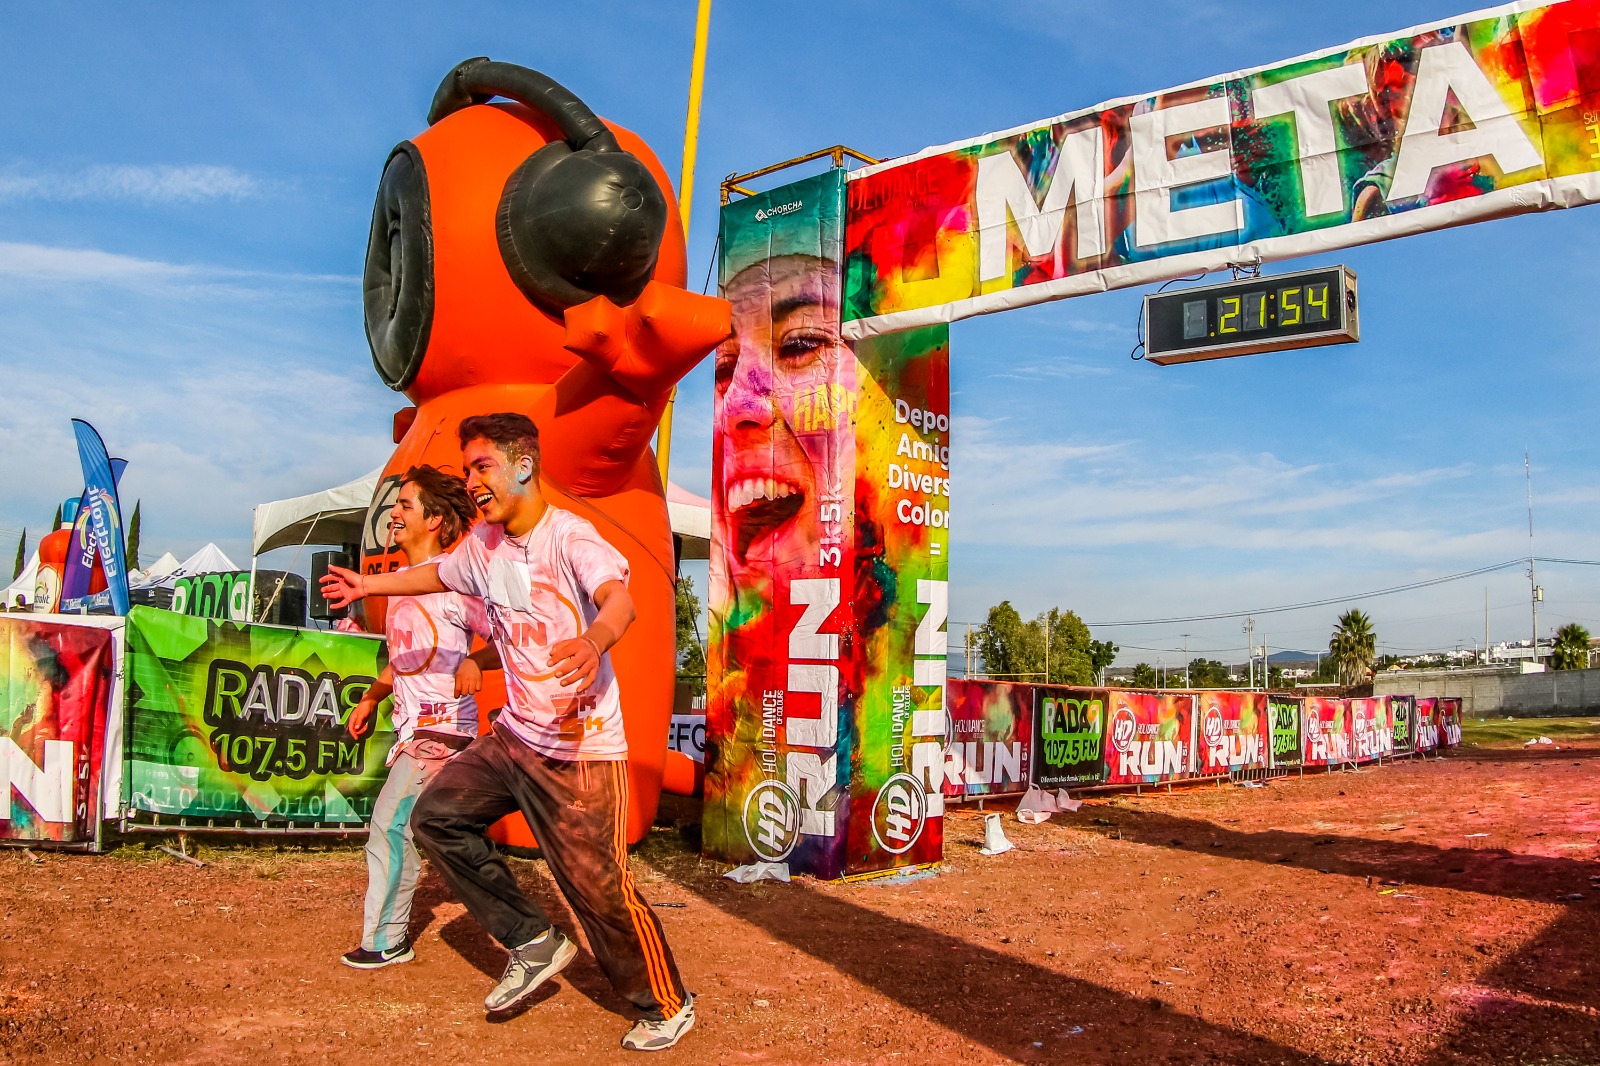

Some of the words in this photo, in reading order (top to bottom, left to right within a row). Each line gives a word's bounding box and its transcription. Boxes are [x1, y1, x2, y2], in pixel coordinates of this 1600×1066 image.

[976, 42, 1545, 282] META
[767, 200, 803, 217] CHORCHA
[895, 398, 949, 434] Depo
[786, 577, 841, 836] RUN
[1045, 702, 1100, 734] RADAR
[1114, 718, 1133, 740] HD
[1359, 728, 1391, 757] RUN
[215, 733, 306, 775] 107.5
[317, 740, 360, 769] FM
[944, 741, 1021, 786] RUN
[1047, 739, 1080, 763] 107.5
[1082, 739, 1098, 757] FM
[1119, 740, 1183, 776] RUN
[1209, 733, 1260, 767] RUN
[1312, 733, 1348, 760] RUN
